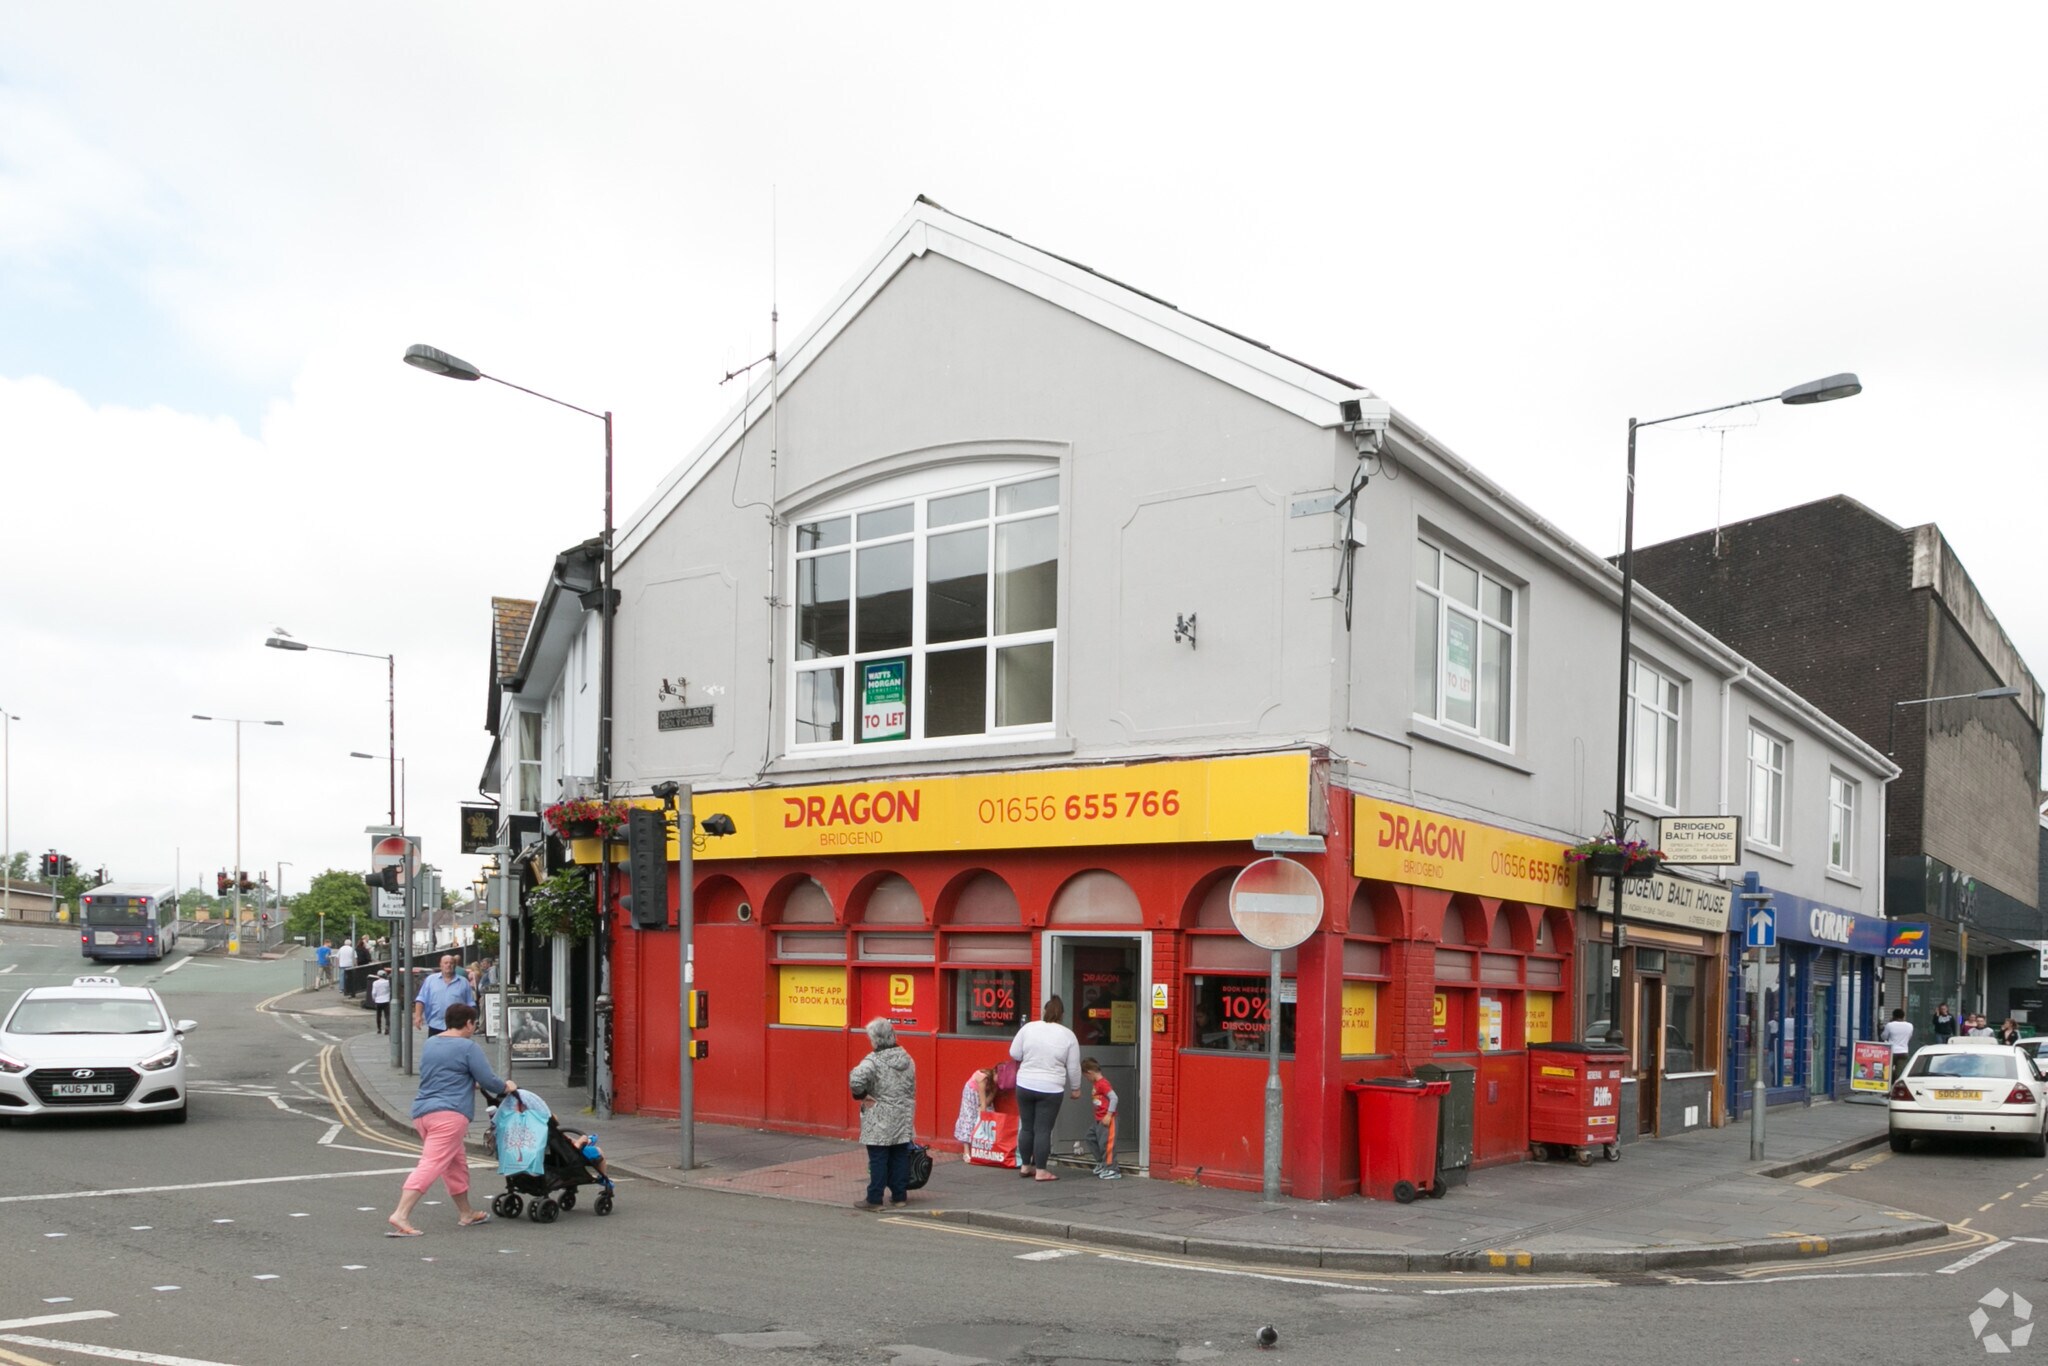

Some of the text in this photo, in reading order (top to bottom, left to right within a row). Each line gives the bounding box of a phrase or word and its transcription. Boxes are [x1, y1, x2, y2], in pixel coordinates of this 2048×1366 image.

[868, 671, 890, 680] WATTS
[1448, 672, 1470, 693] TO LET
[868, 679, 901, 688] MORGAN
[693, 706, 711, 716] ROAD
[865, 712, 904, 728] TO LET
[783, 789, 920, 828] DRAGON
[978, 789, 1180, 823] 01656 655 766
[1674, 822, 1725, 830] BRIDGEND
[820, 831, 883, 846] BRIDGEND
[1378, 811, 1466, 862] DRAGON
[1666, 832, 1733, 840] BALTI HOUSE
[1403, 859, 1444, 879] BRIDGEND
[1491, 850, 1570, 887] 01656 655 766
[1667, 882, 1693, 907] BALTI
[1696, 889, 1725, 914] HOUSE
[1810, 908, 1849, 944] CORAL
[1887, 947, 1925, 956] CORAL
[1613, 965, 1619, 974] 5
[1082, 973, 1120, 983] DRAGON
[811, 986, 824, 994] THE
[827, 987, 842, 995] APP
[788, 996, 798, 1004] TO
[973, 988, 1014, 1009] 10%
[973, 1010, 1014, 1020] DISCOUNT
[1222, 996, 1271, 1020] 10%
[1354, 1007, 1365, 1016] APP
[60, 1082, 113, 1095] KU67 WLR
[971, 1147, 1005, 1162] BARGAINS
